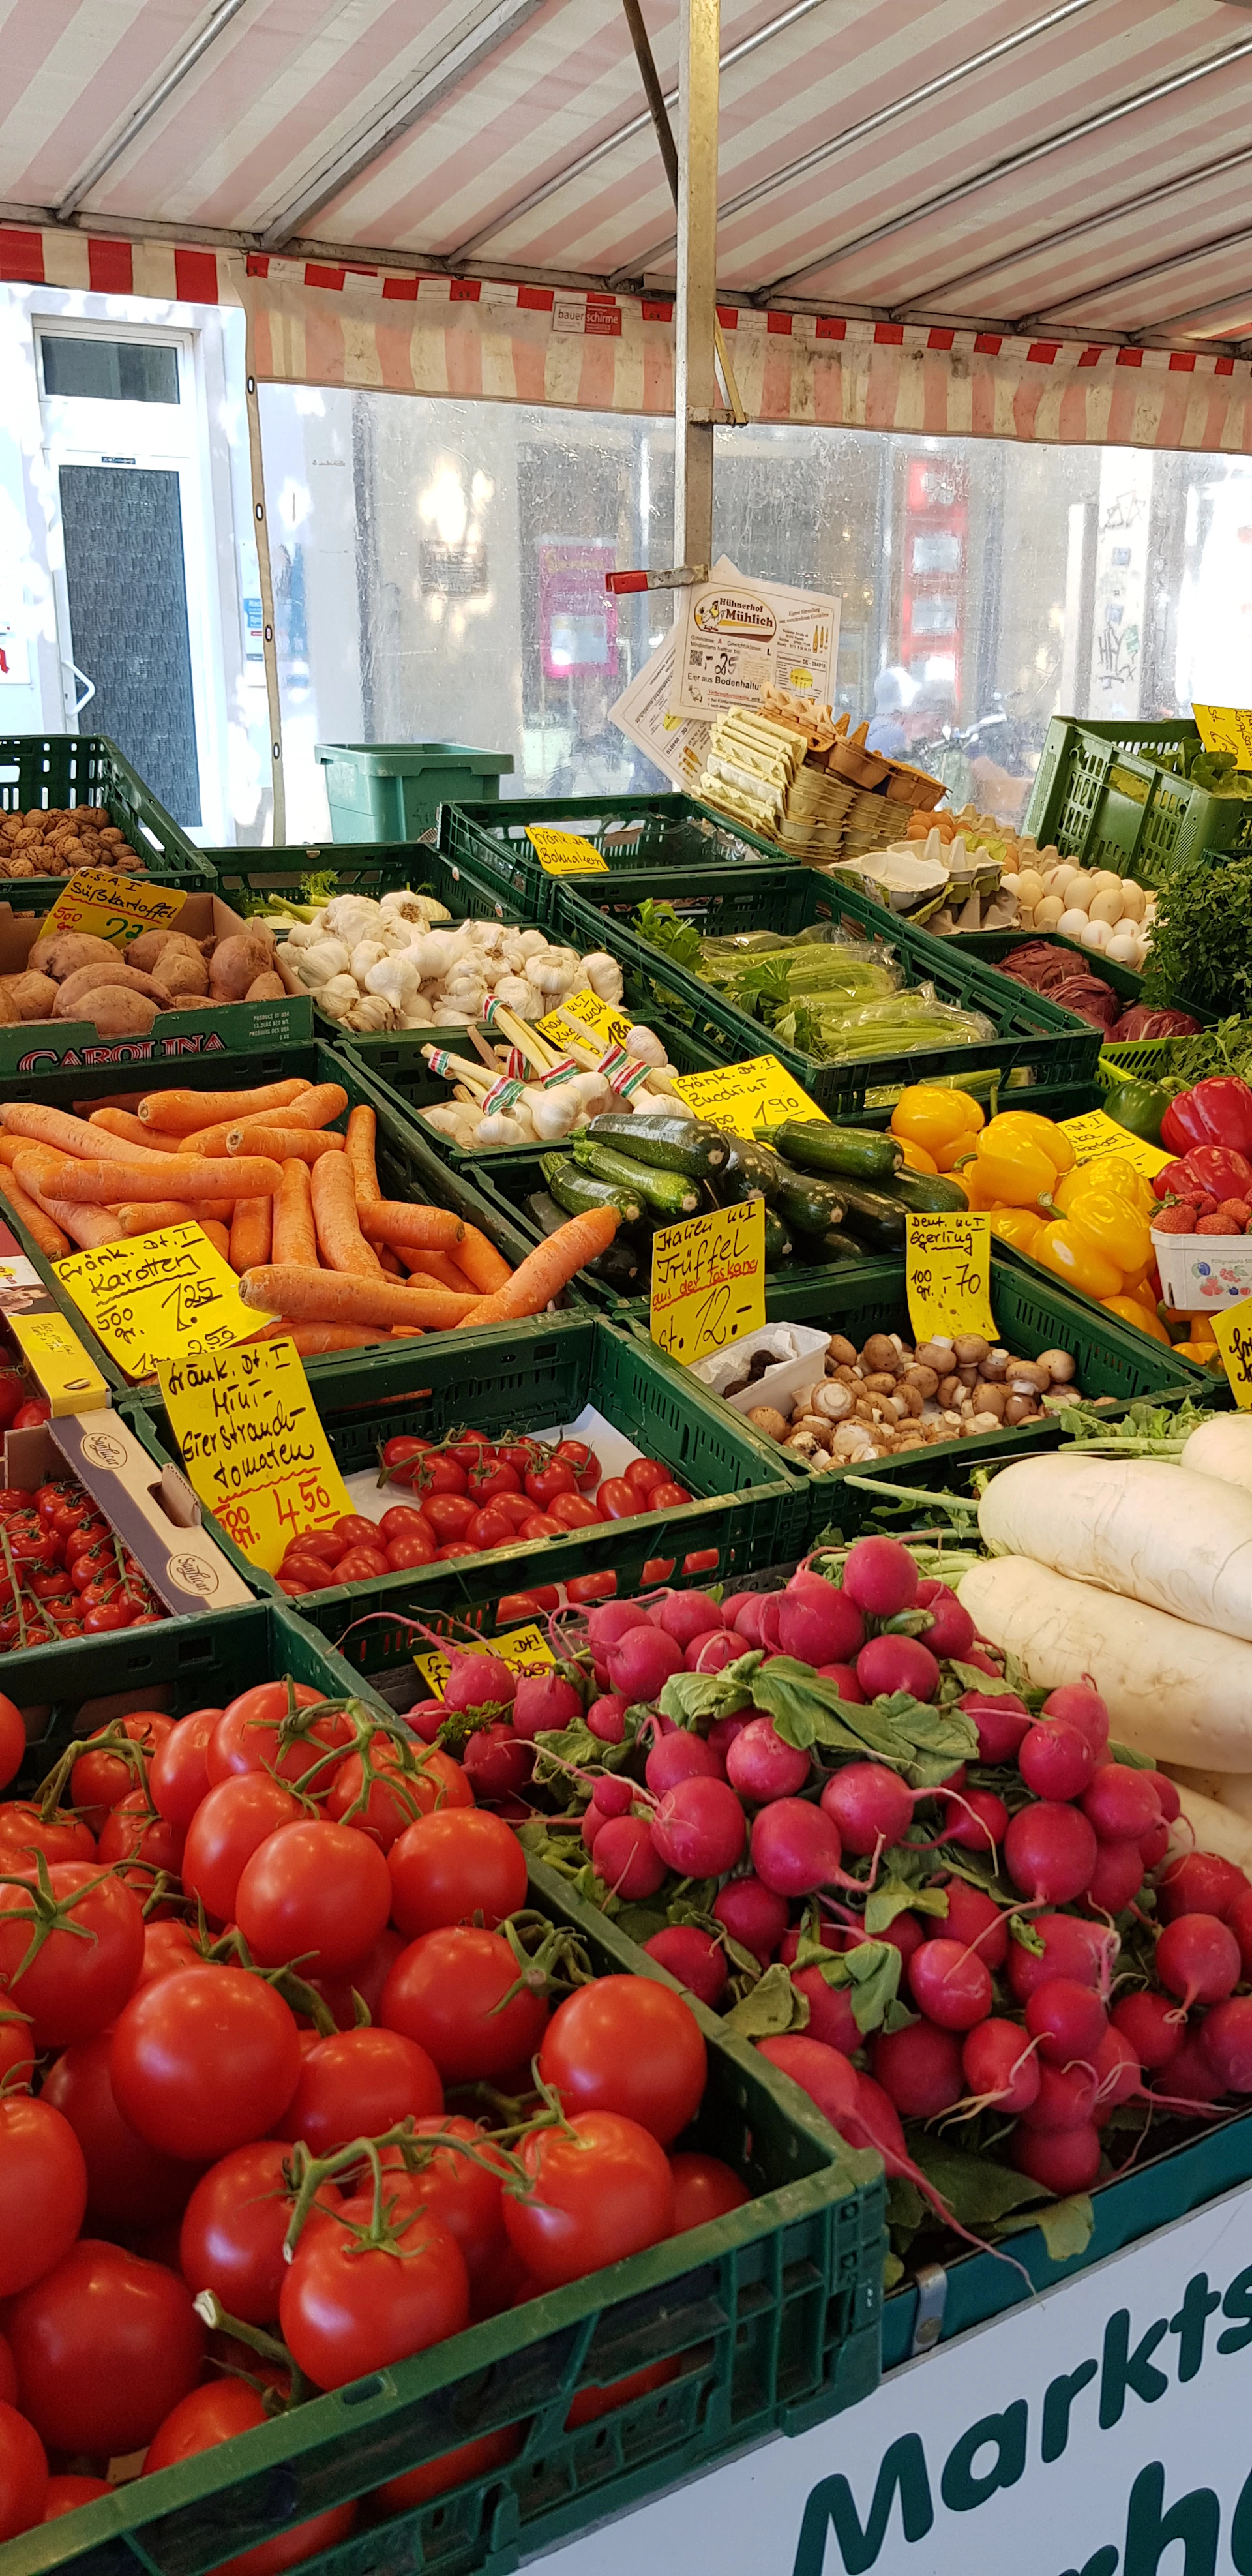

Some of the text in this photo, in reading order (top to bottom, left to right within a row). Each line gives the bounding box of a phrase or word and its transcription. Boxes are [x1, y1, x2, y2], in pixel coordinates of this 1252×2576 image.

[558, 308, 584, 320] bauer
[586, 312, 619, 324] schirme
[720, 597, 764, 613] Hühnerhof
[725, 608, 773, 627] Mühlich
[687, 672, 700, 681] Eier
[715, 676, 762, 691] Bodenhaltu
[70, 882, 177, 920] Süßkartoffel
[53, 906, 82, 923] 500
[18, 1032, 227, 1072] CAROLINA
[657, 1227, 750, 1284] Trüffel
[88, 1253, 201, 1297] Karotten
[910, 1269, 932, 1285] 100
[652, 1287, 672, 1307] aus
[679, 1276, 701, 1296] der
[95, 1304, 134, 1331] 500
